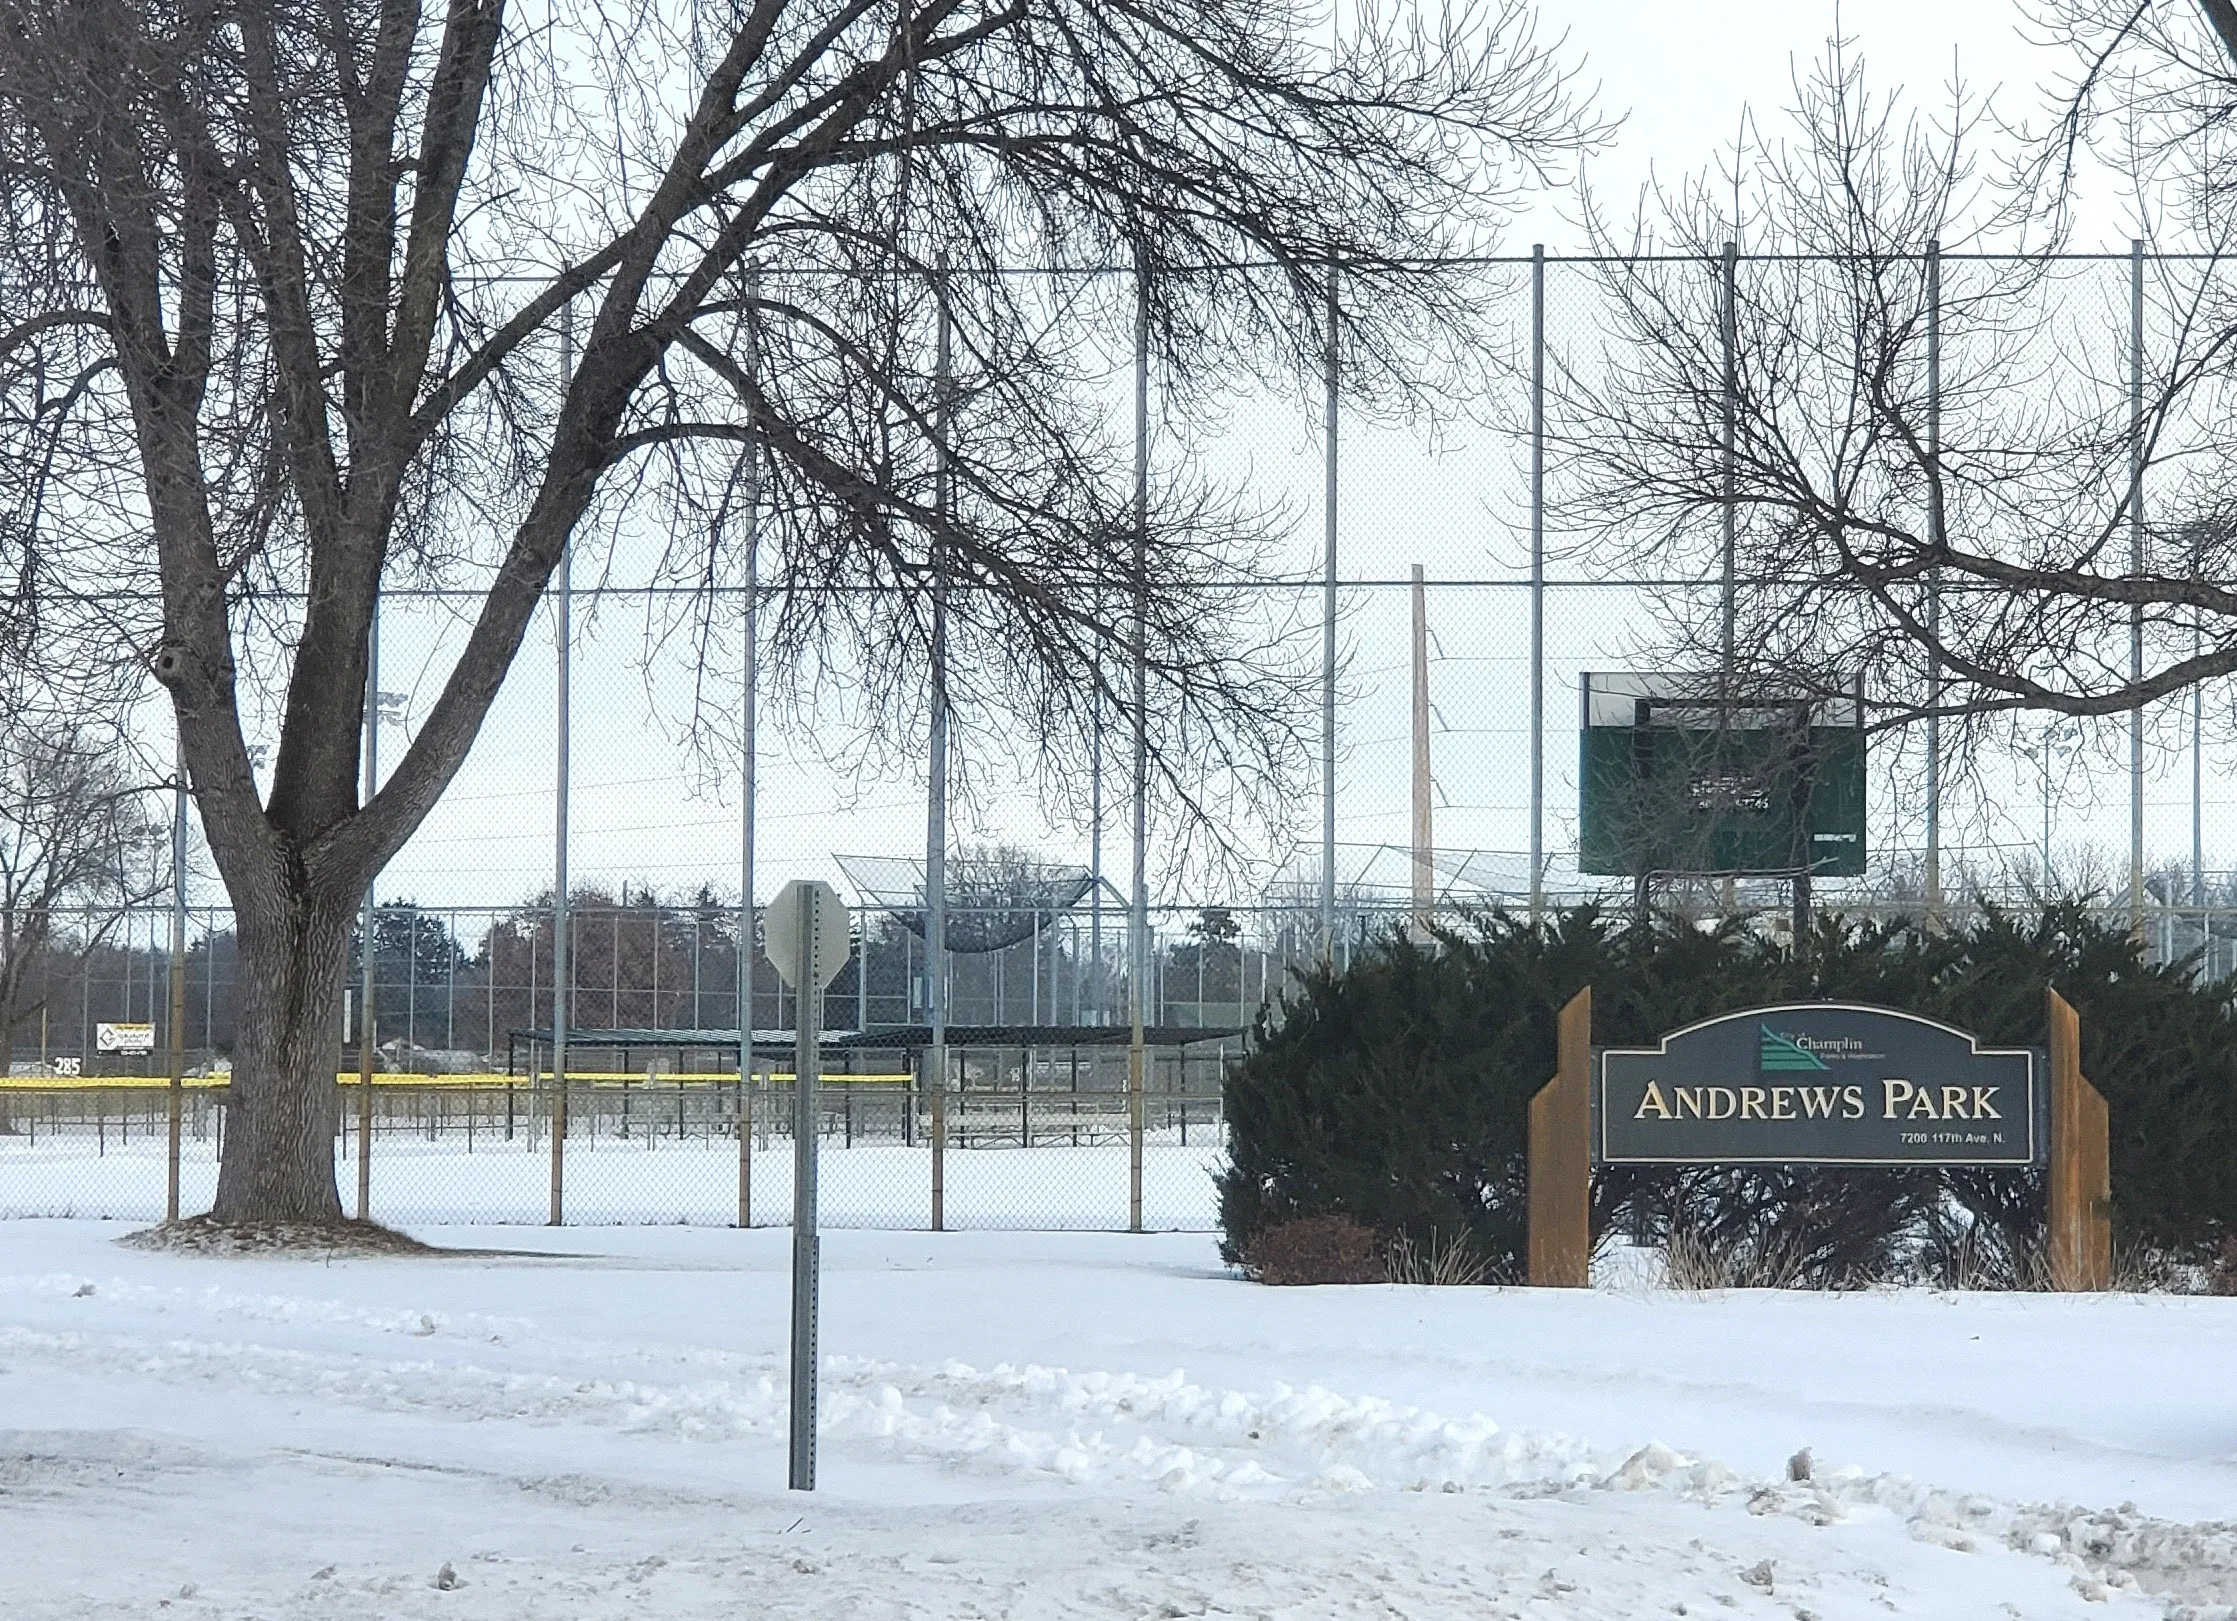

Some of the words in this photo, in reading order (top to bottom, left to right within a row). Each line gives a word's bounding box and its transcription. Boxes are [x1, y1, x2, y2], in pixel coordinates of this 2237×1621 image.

[1796, 1037, 1862, 1052] Champlin
[54, 1057, 81, 1075] 285
[1634, 1080, 1864, 1119] ANDREWS
[1882, 1079, 2002, 1119] PARK
[1900, 1132, 1928, 1144] 7200
[1931, 1132, 1962, 1144] 117th
